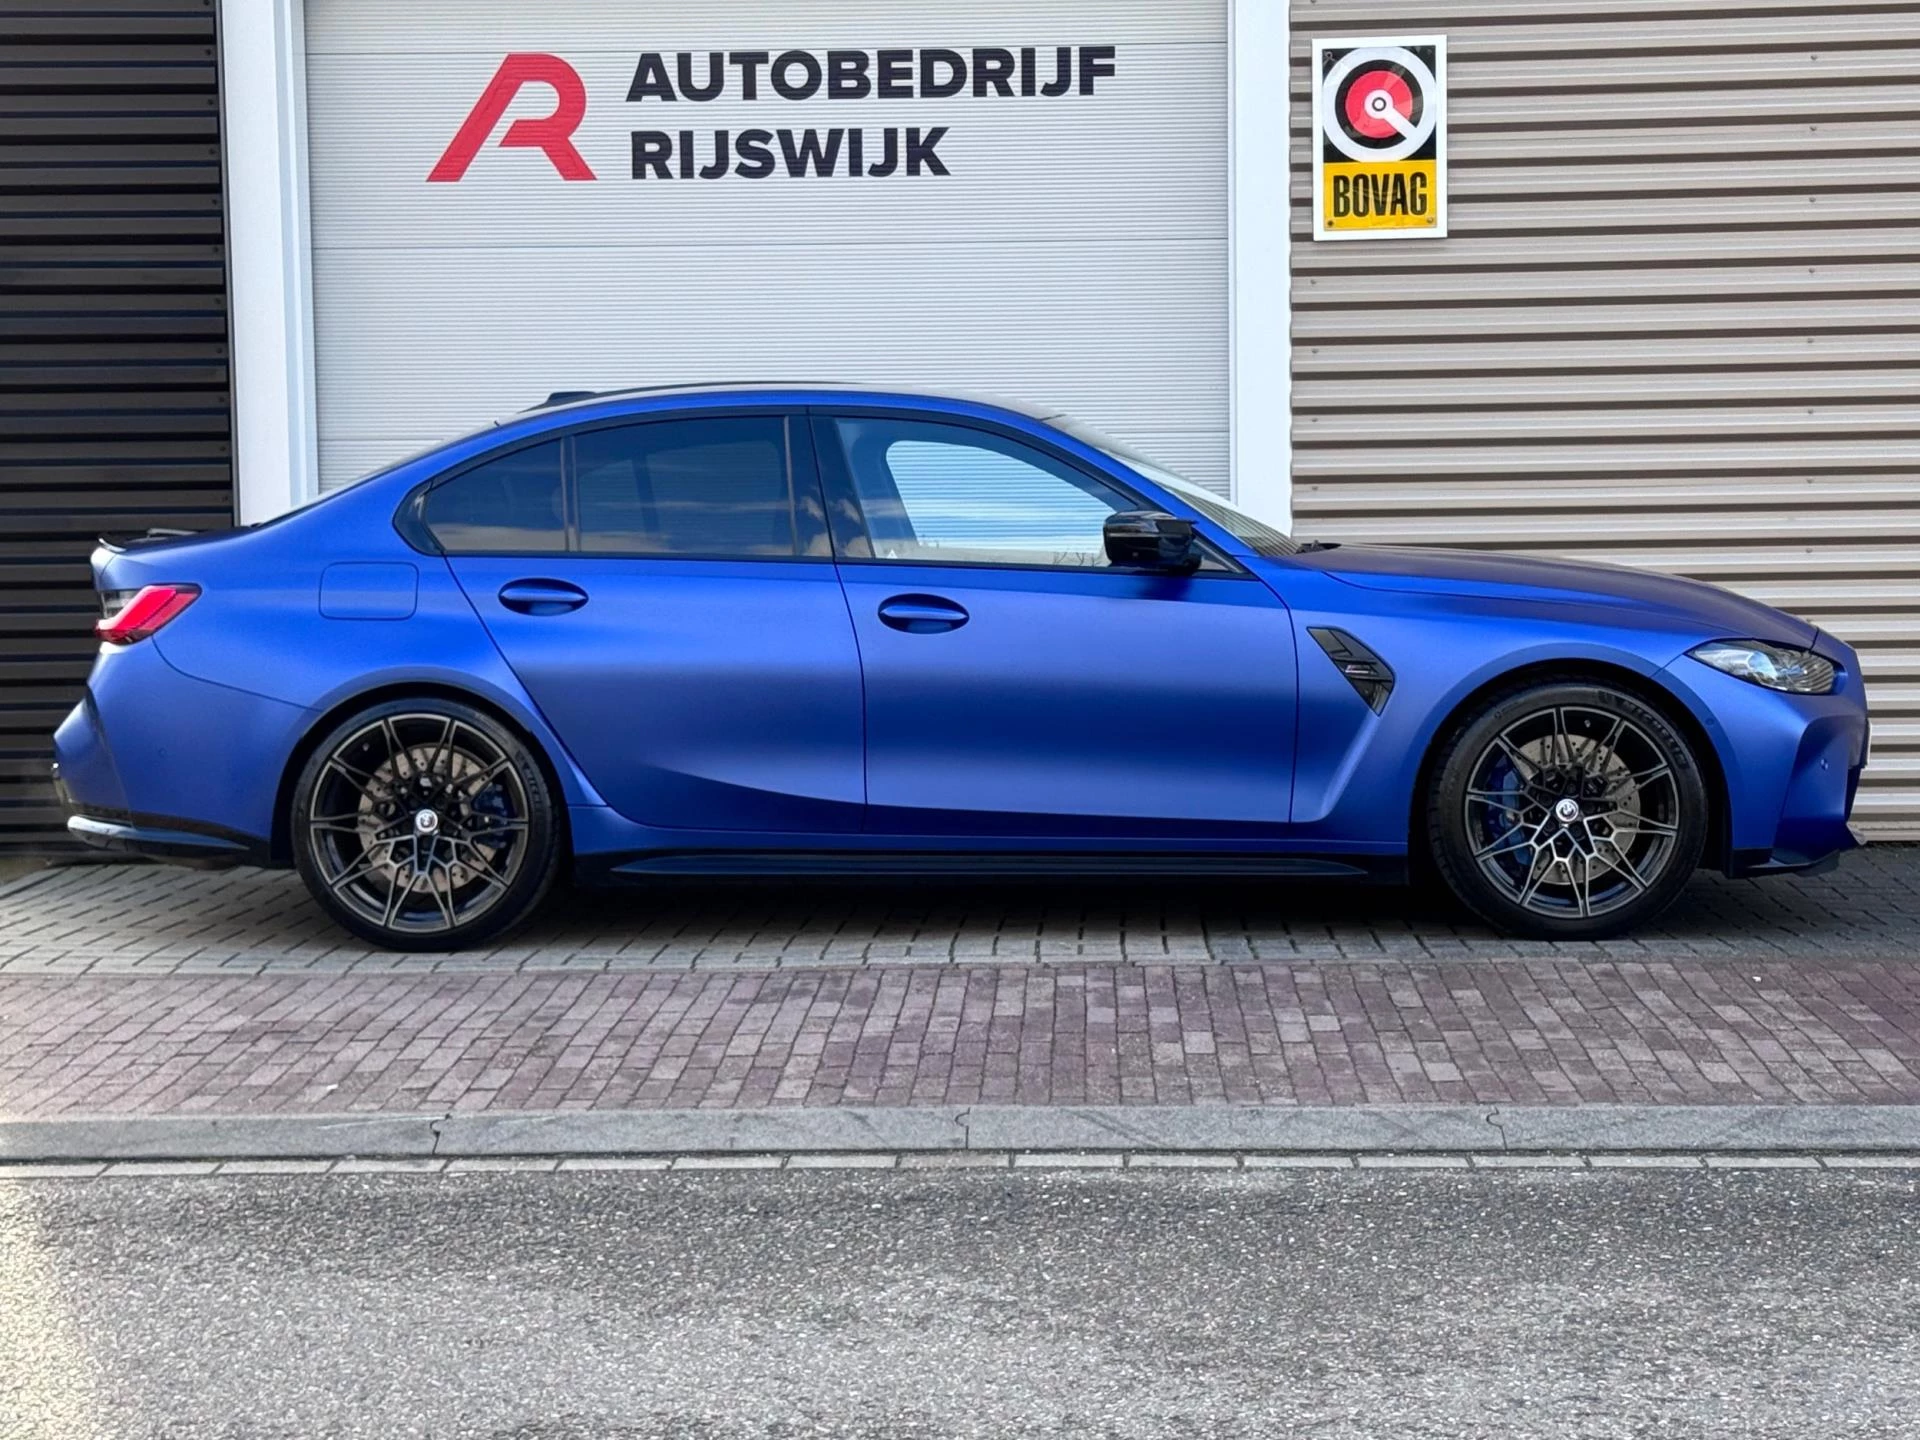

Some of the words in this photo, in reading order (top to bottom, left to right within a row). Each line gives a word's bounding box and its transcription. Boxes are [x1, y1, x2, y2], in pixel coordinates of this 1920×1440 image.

[626, 46, 1116, 103] AUTOBEDRIJF
[631, 127, 950, 180] RIJSWIJK
[1333, 172, 1428, 218] BOVAG
